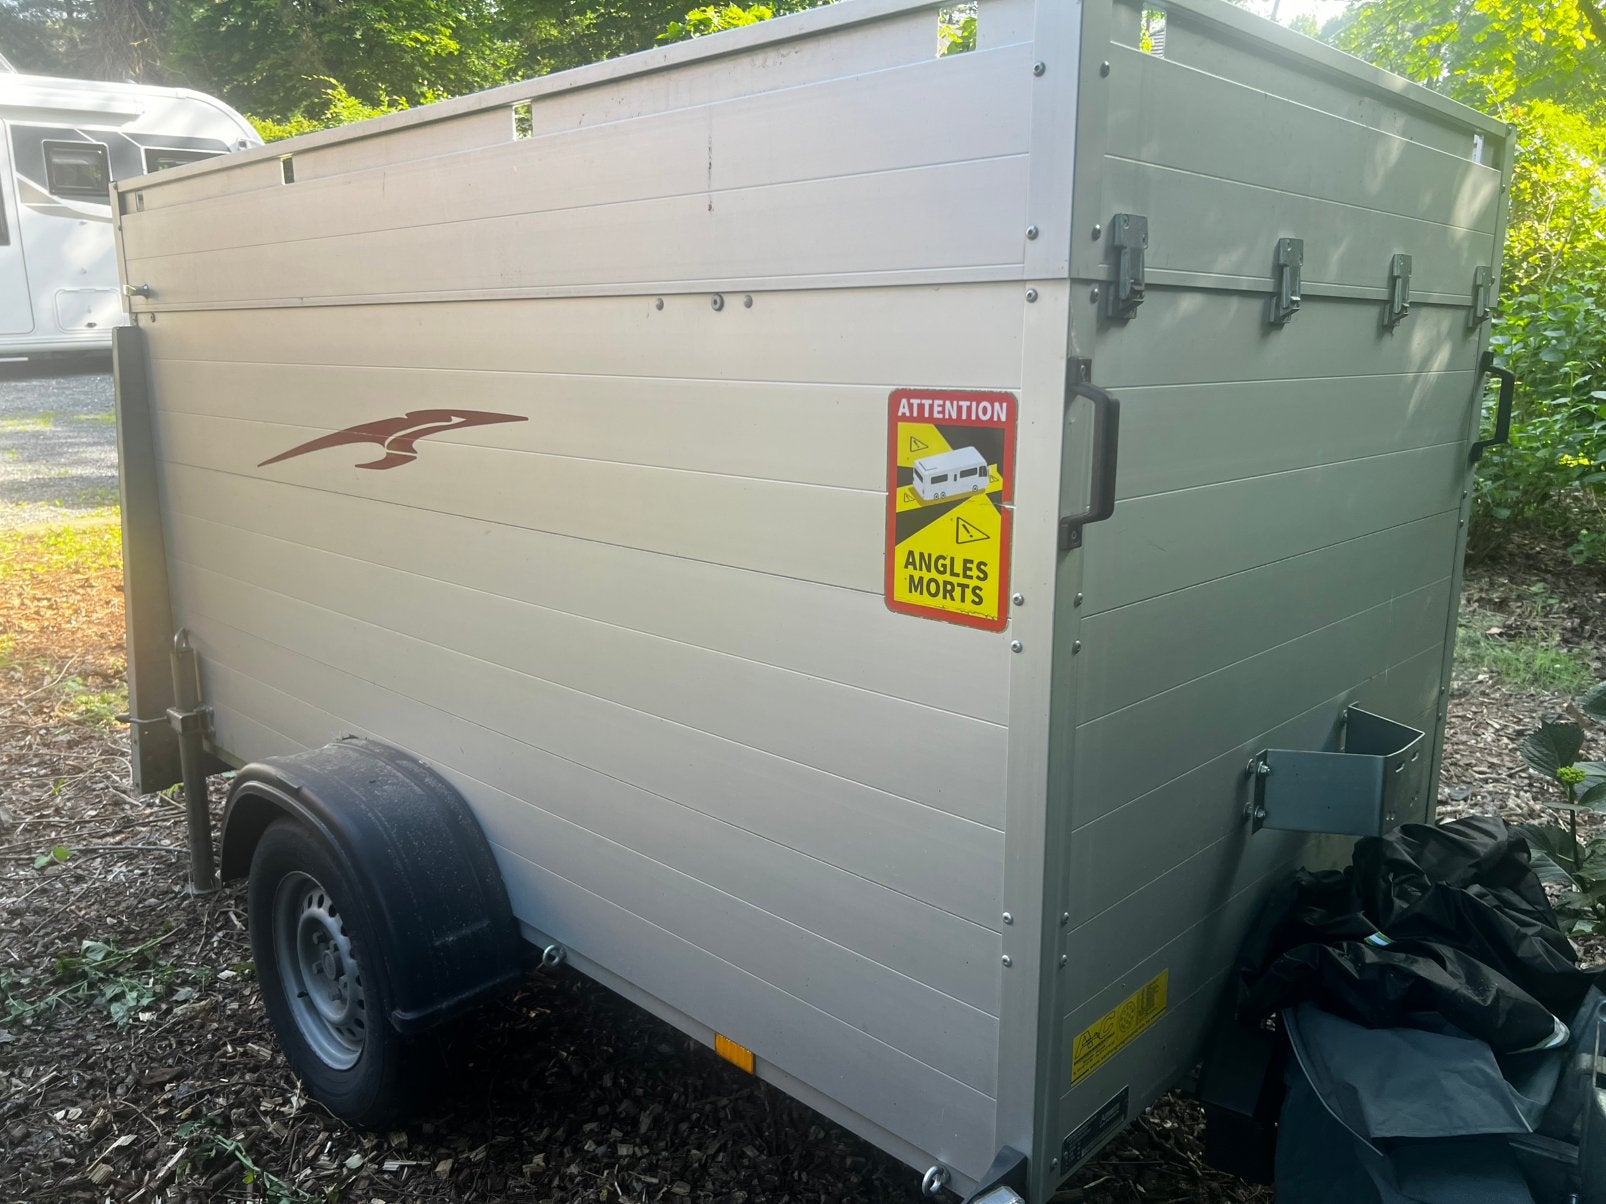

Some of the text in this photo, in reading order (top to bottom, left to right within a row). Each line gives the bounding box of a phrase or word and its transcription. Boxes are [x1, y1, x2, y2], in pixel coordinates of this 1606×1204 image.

[897, 398, 1007, 422] ATTENTION
[903, 550, 989, 582] ANGLES
[908, 574, 984, 606] MORTS
